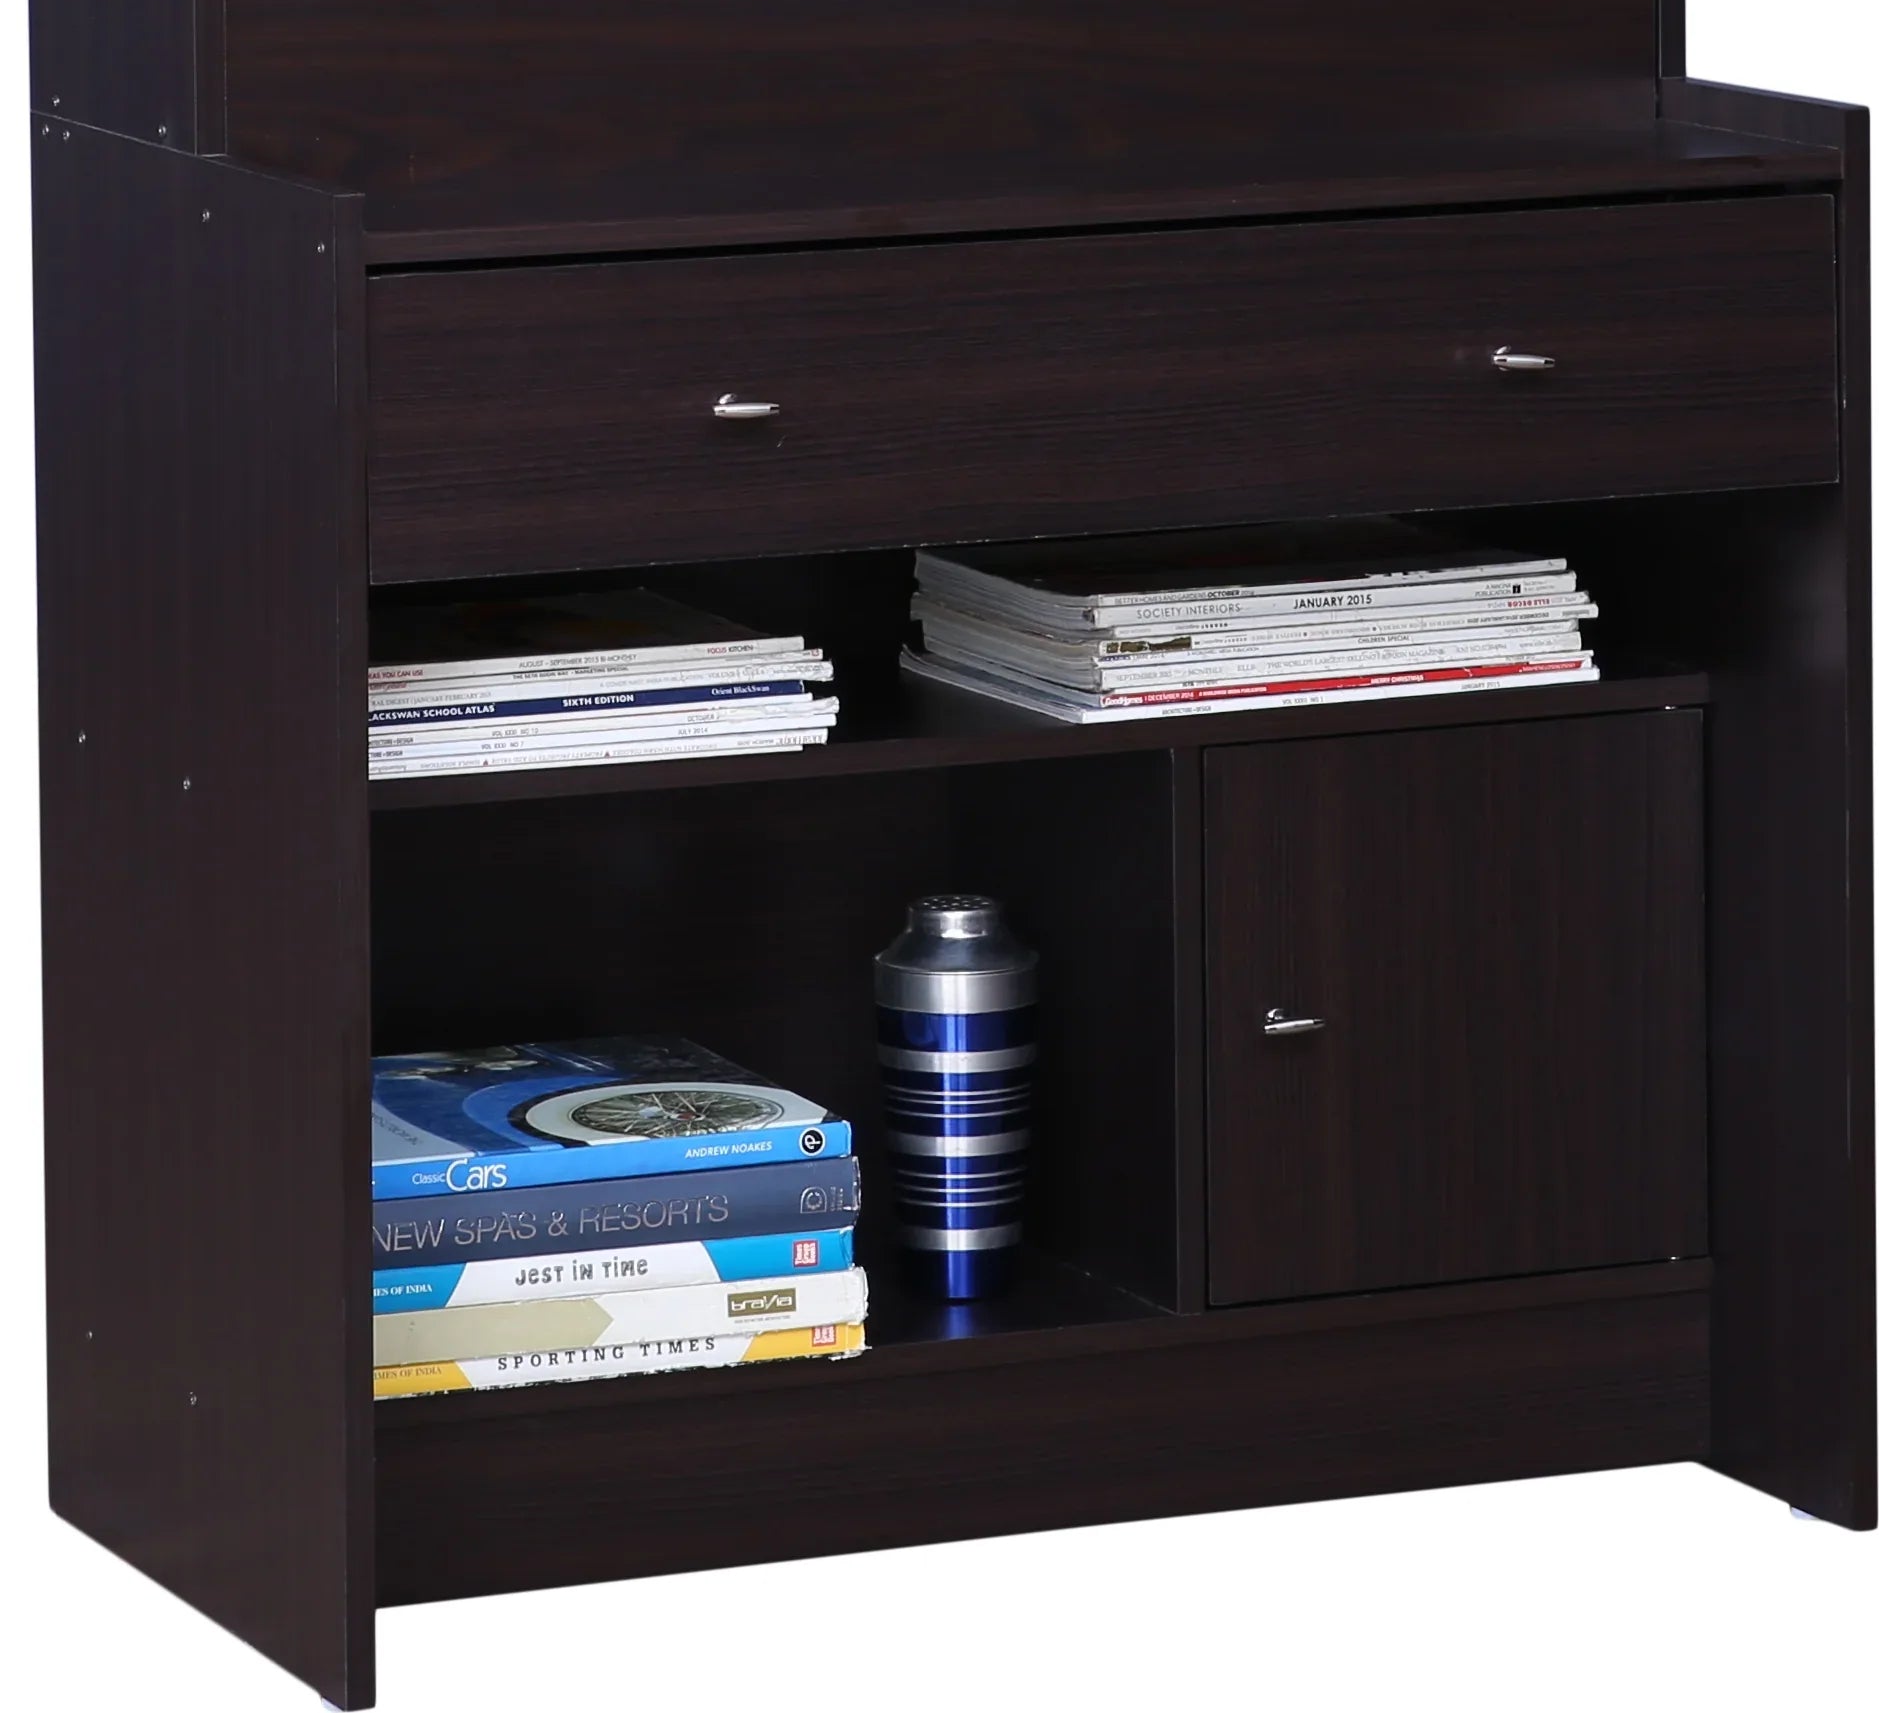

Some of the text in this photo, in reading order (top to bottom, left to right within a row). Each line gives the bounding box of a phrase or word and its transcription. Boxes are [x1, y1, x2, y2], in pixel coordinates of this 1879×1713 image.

[1207, 589, 1240, 598] OCTOBER
[1293, 594, 1372, 609] JANUARY 2015
[1507, 599, 1532, 608] DECOR
[1534, 598, 1550, 606] ELLE
[1137, 603, 1241, 619] SOCIETY INTERIORS
[519, 659, 543, 669] AUGUST
[1391, 674, 1424, 684] CHRISTMAS
[562, 694, 634, 707] SIXTH EDITION
[1147, 692, 1179, 702] DECEMBER
[423, 706, 463, 718] SCHOOL
[465, 704, 495, 715] ATLAS
[685, 1141, 773, 1159] ANDREW NOAKES
[412, 1158, 508, 1192] Classic Cars
[372, 1195, 729, 1252] NEW SPAS & RESORTS
[391, 1286, 404, 1296] OF
[406, 1283, 433, 1294] INDIA
[498, 1337, 715, 1371] SPORTING TIMES
[400, 1369, 412, 1378] OF
[416, 1366, 442, 1376] INDIA
